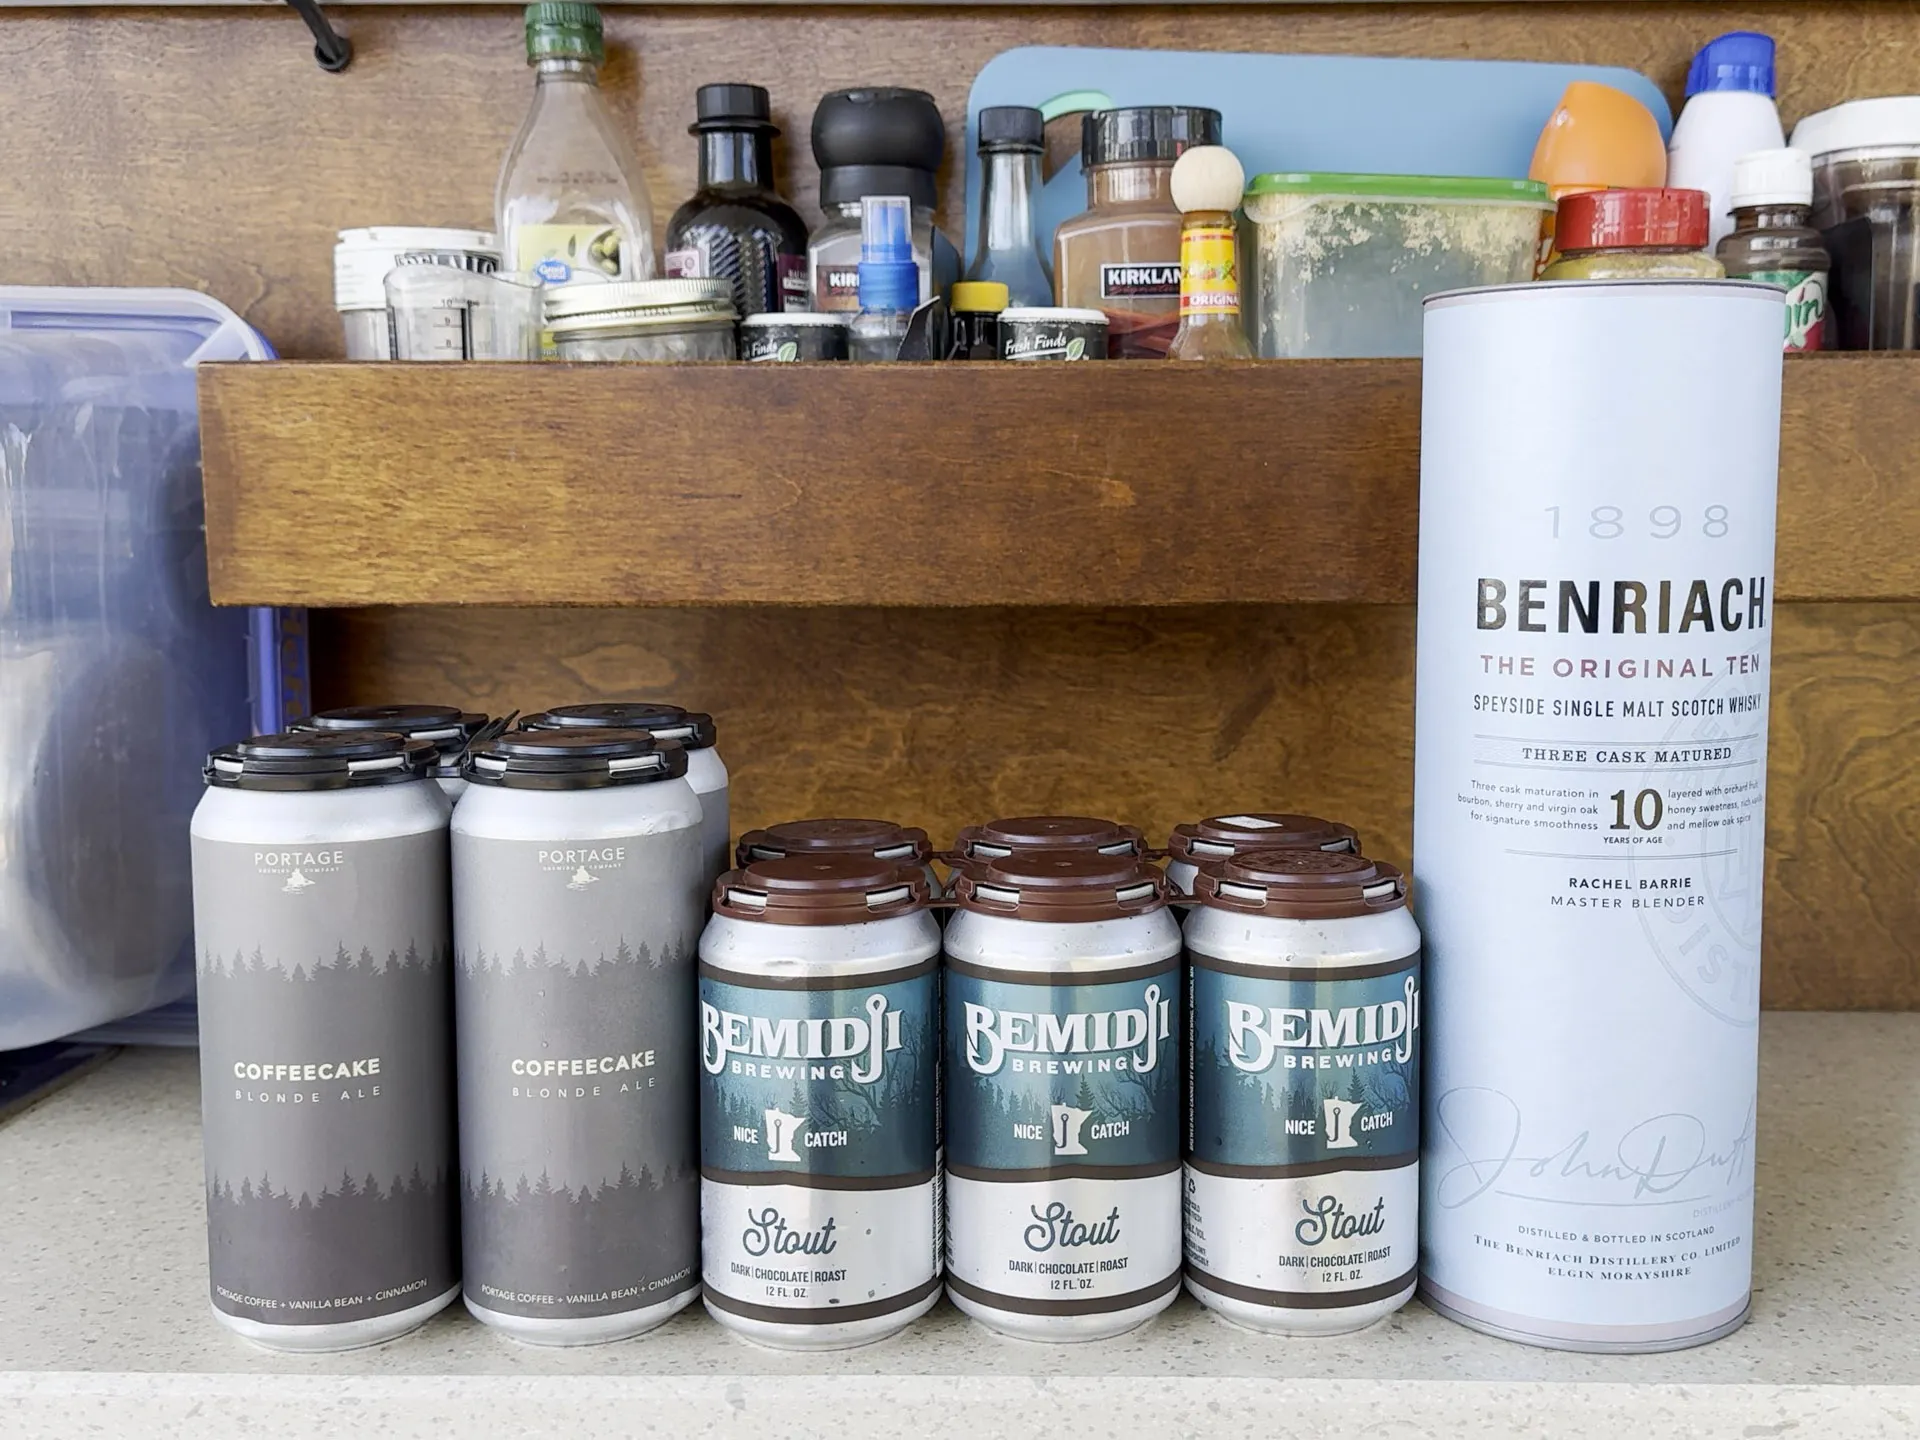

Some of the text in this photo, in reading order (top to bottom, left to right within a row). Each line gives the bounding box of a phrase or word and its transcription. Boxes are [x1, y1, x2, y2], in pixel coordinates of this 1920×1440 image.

[1108, 268, 1181, 285] KIRKLAN
[1190, 295, 1240, 306] ORIGINA
[752, 337, 778, 356] Finds
[1006, 331, 1066, 354] Fresh Finds
[1545, 505, 1729, 539] 1898
[1476, 577, 1766, 634] BENRIACH
[1480, 654, 1760, 679] THE ORIGINAL TEN
[1474, 693, 1761, 718] SPEYSIDE SINGLE MALT SCOTCH WHISKY
[1522, 747, 1732, 764] THREE CASK MATURED
[1471, 780, 1599, 798] Three cask maturation in
[1668, 788, 1702, 800] layered
[1705, 786, 1722, 796] with
[1458, 793, 1599, 815] bourbon, sherry and virgin oak
[1609, 788, 1664, 831] 10
[1668, 804, 1696, 815] honey
[1699, 802, 1740, 812] sweetness,
[1470, 810, 1599, 830] for signature smoothness
[1667, 820, 1686, 830] and
[1688, 818, 1720, 829] mellow
[1722, 816, 1734, 826] oak
[1603, 836, 1663, 844] YEARS OF AGE
[254, 851, 344, 866] PORTAGE
[539, 847, 625, 864] PORTAGE
[1569, 878, 1692, 890] RACHEL BARRIE
[1551, 896, 1705, 908] MASTER BLENDER
[964, 984, 1171, 1074] BEMIDJI
[1226, 976, 1420, 1072] BEMIDJI
[702, 993, 904, 1083] BEMIDJI
[512, 1050, 655, 1076] COFFEECAKE
[1012, 1056, 1127, 1074] BREWING
[1284, 1050, 1392, 1069] BREWING
[234, 1058, 380, 1082] COFFEECAKE
[732, 1060, 844, 1080] BREWING
[235, 1086, 380, 1103] BLONDE ALE
[512, 1078, 655, 1098] BLONDE ALE
[1014, 1120, 1130, 1140] NICE CATCH
[1285, 1111, 1393, 1135] NICE CATCH
[734, 1125, 847, 1148] NICE CATCH
[1024, 1202, 1121, 1252] Stout
[1295, 1195, 1385, 1246] Stout
[742, 1208, 837, 1256] Stout
[1518, 1225, 1715, 1244] DISTILLED & BOTTLED IN SCOTLAND
[1473, 1234, 1500, 1250] THE
[1505, 1243, 1582, 1264] BENRIACH
[1589, 1254, 1676, 1266] DISTILLERY
[1704, 1236, 1741, 1256] LIMITED
[1322, 1269, 1363, 1282] 12 FL. OZ.
[1548, 1266, 1692, 1280] ELGIN MORAYSHIRE
[216, 1284, 243, 1304] PORTAGE
[244, 1295, 277, 1309] COFFEE
[289, 1300, 332, 1309] VANILLA
[334, 1296, 363, 1308] BEAN
[376, 1278, 428, 1301] CINNAMON
[482, 1284, 515, 1300] PORTAGE
[518, 1293, 554, 1304] COFFEE
[566, 1292, 608, 1304] VANILLA
[611, 1286, 638, 1299] BEAN
[648, 1266, 691, 1291] CINNAMON
[766, 1286, 808, 1298] 12 FL. OZ.
[1050, 1278, 1094, 1290] 12 FL. OZ.
